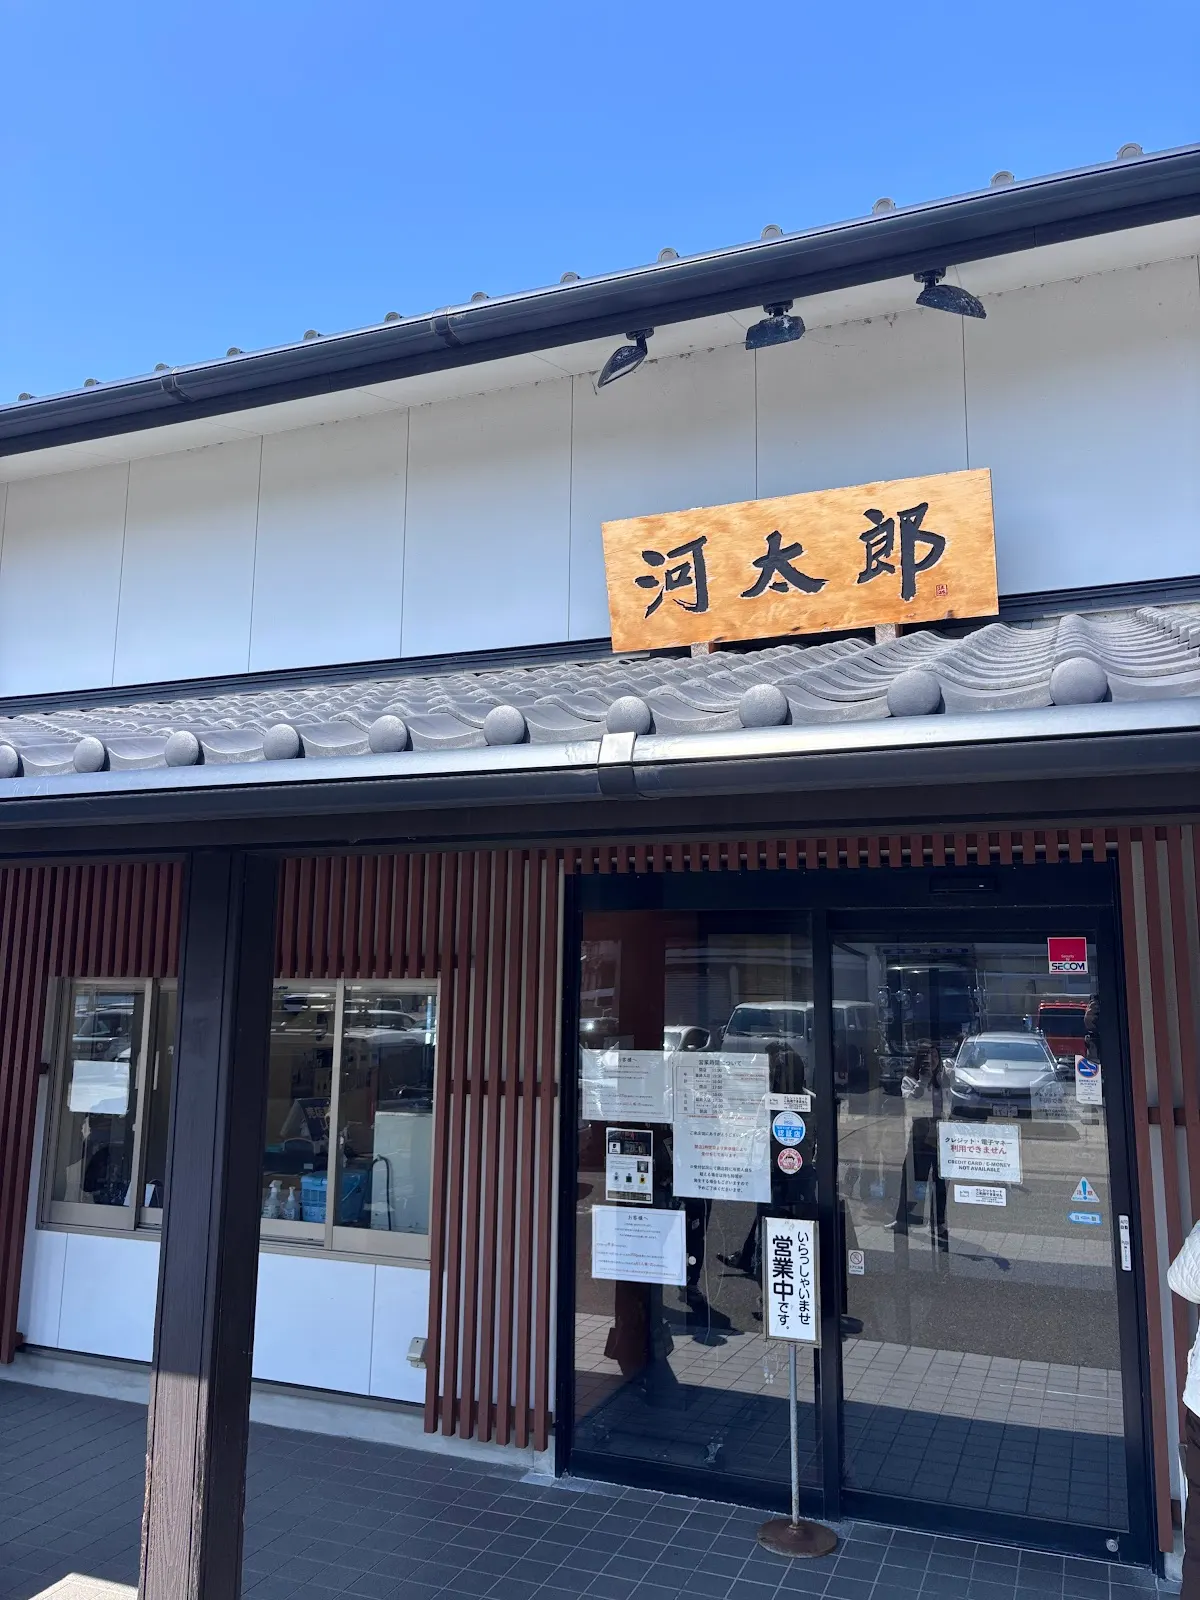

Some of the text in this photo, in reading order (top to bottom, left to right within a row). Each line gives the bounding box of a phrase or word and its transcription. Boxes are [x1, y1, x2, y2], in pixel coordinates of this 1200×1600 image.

[635, 502, 946, 619] 河太郎
[1051, 962, 1085, 971] SECOM
[777, 1129, 801, 1138] 認証店
[945, 1137, 1013, 1146] クレジット・電子マネー
[951, 1144, 1007, 1155] 利用できません
[772, 1234, 794, 1330] 営業中です。
[797, 1231, 811, 1325] いらっしゃいませ
